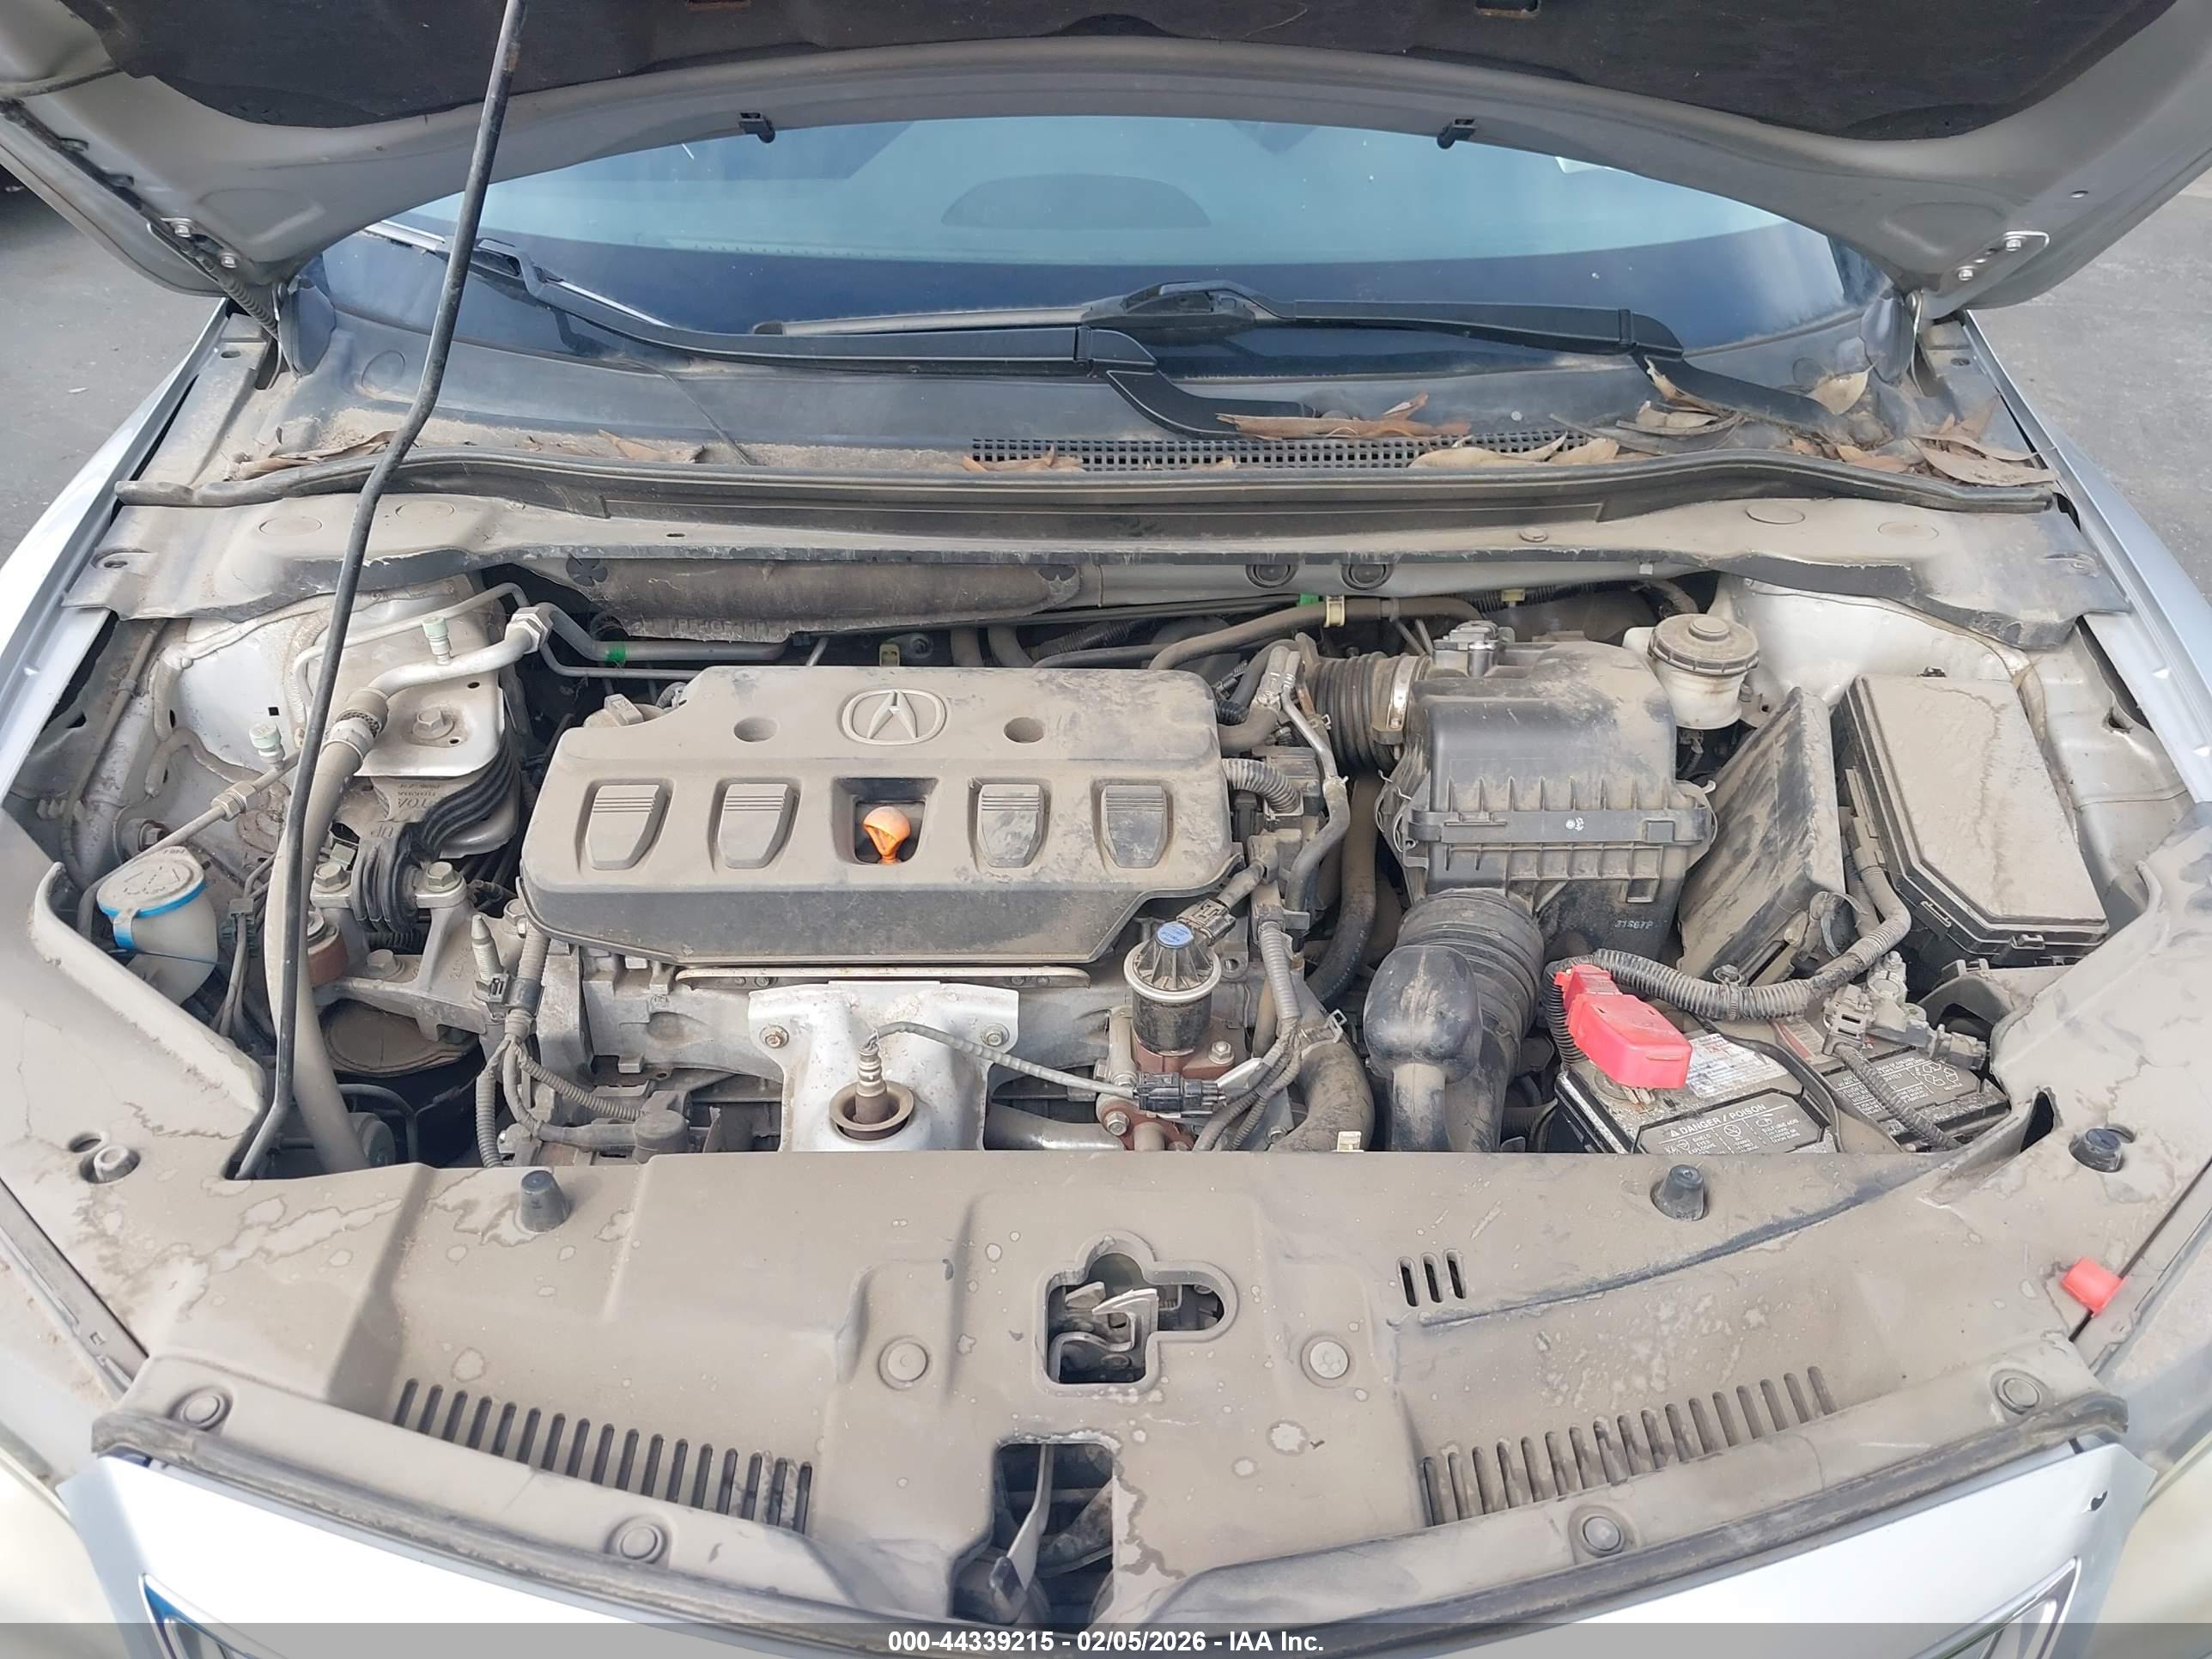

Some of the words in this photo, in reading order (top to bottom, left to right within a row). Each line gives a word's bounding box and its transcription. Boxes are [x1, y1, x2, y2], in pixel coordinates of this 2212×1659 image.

[1680, 1117, 1720, 1134] DANGER
[1722, 1114, 1728, 1122] /
[1729, 1103, 1766, 1119] POISON
